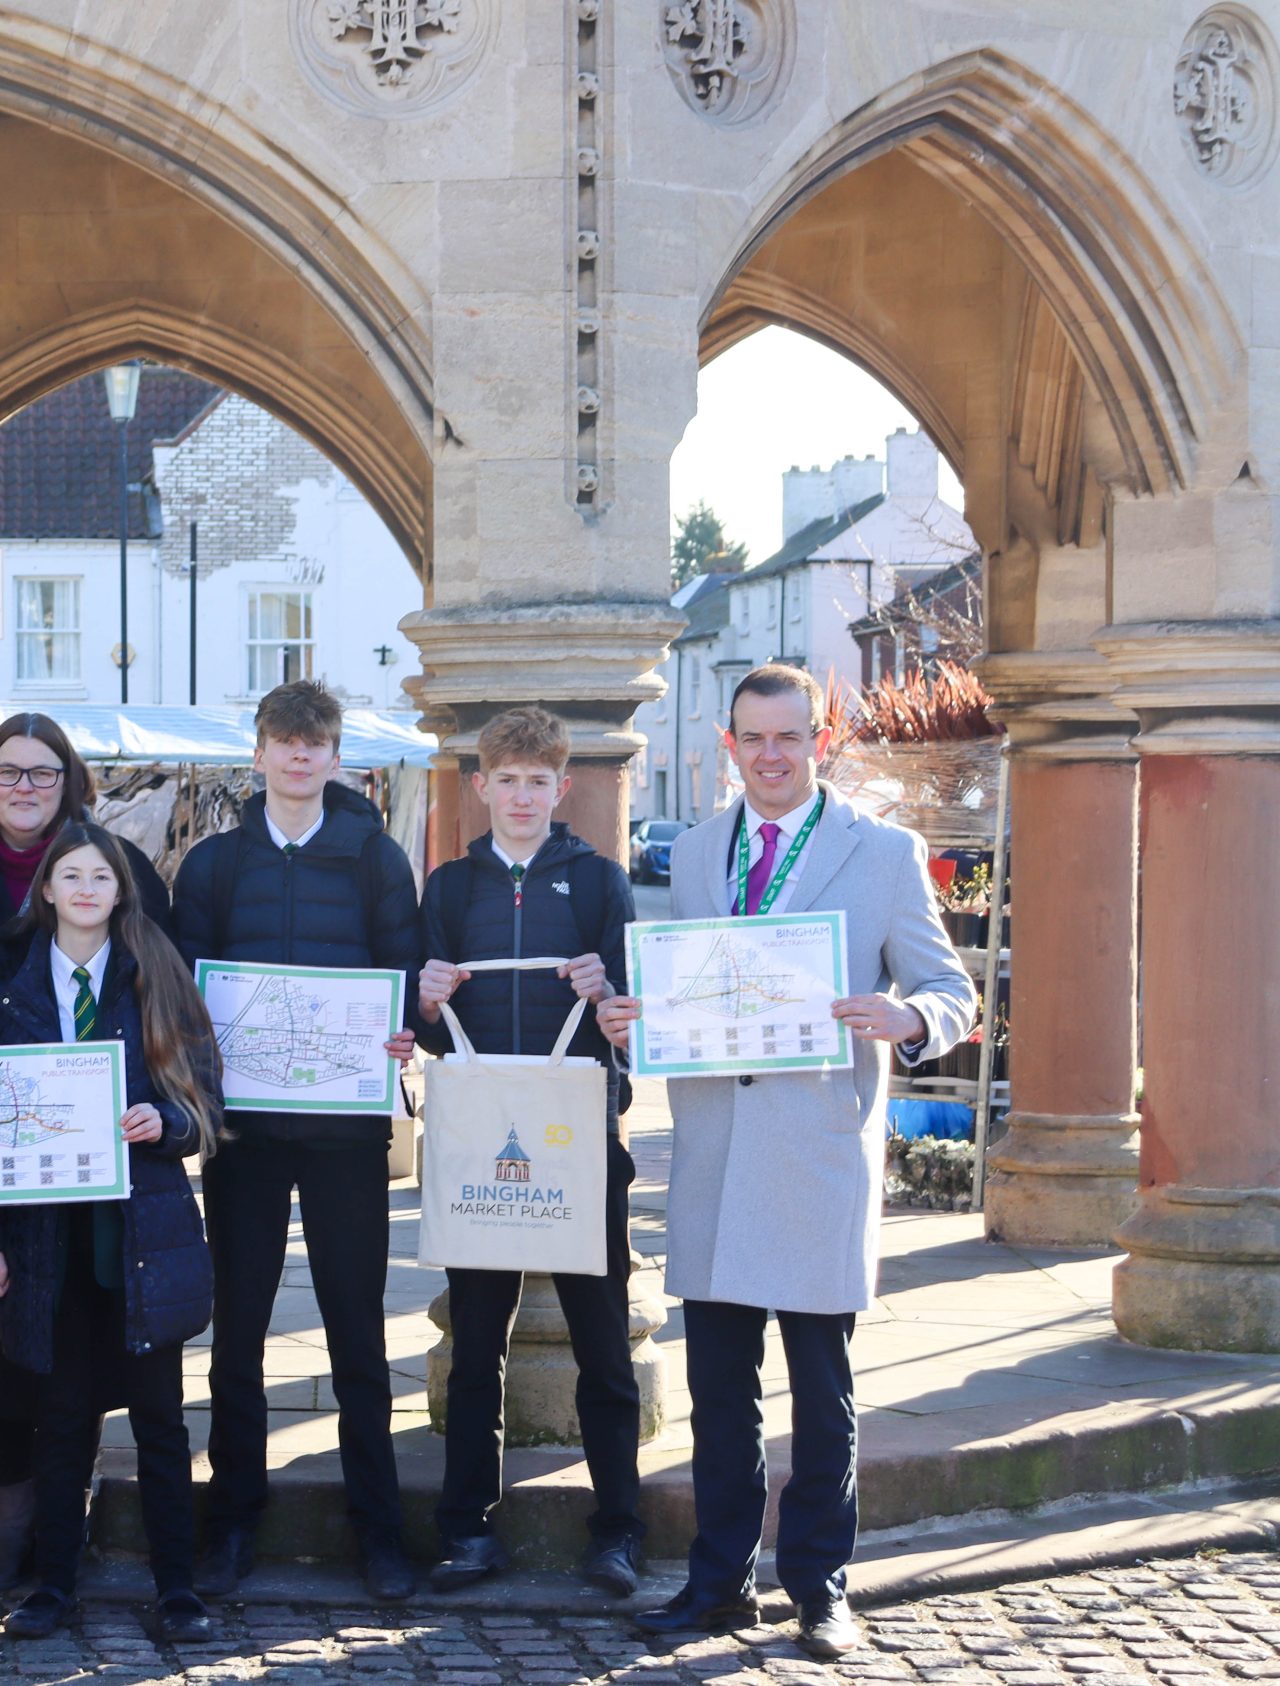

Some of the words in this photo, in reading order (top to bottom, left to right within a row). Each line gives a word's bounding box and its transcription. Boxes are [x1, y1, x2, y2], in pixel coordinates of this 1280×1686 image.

[776, 926, 830, 938] BINGHAM
[56, 1056, 110, 1068] BINGHAM
[461, 1184, 564, 1204] BINGHAM
[451, 1203, 516, 1217] MARKET
[521, 1204, 573, 1220] PLACE
